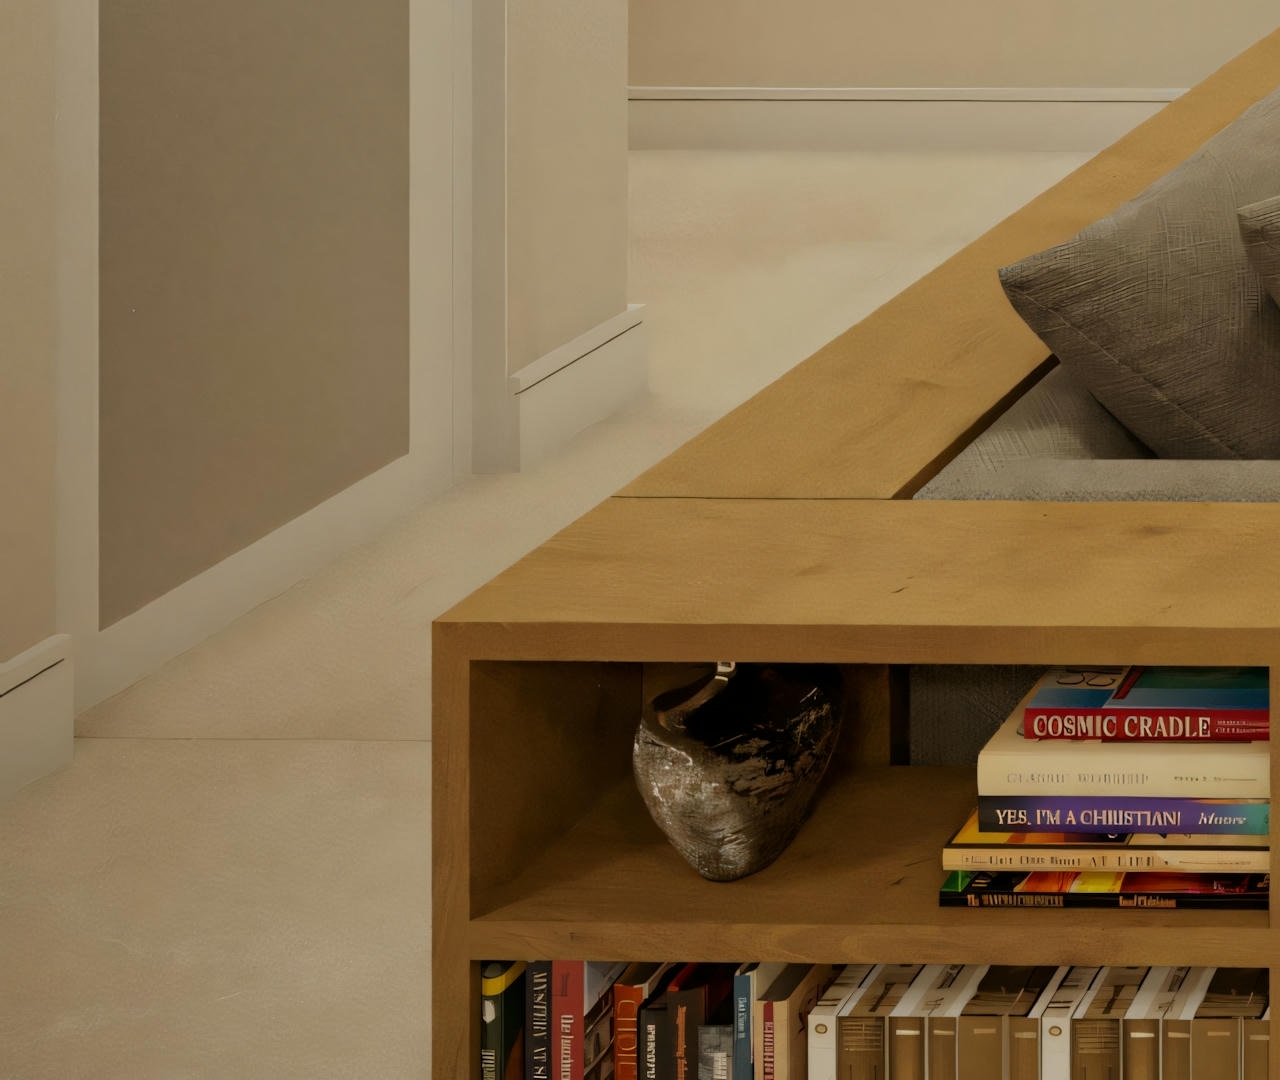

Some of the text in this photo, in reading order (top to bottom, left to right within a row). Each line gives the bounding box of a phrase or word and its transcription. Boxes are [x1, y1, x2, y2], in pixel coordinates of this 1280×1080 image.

[1033, 715, 1117, 737] COSMIC
[1124, 716, 1211, 738] CRADLE
[1065, 809, 1077, 825] A
